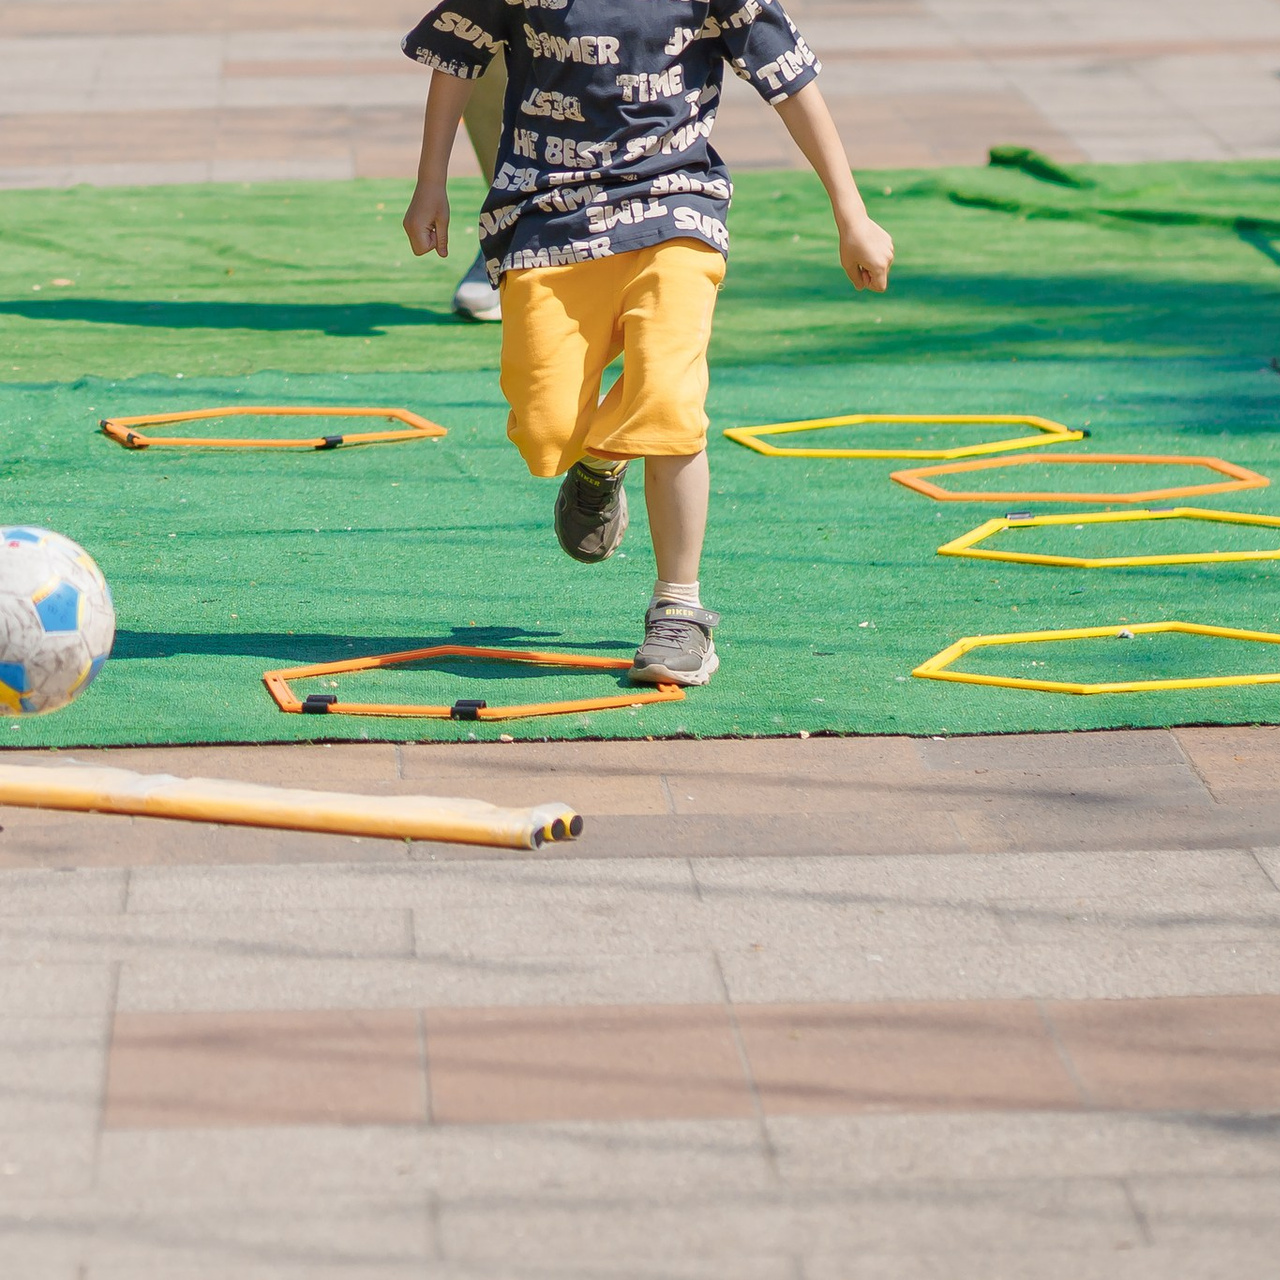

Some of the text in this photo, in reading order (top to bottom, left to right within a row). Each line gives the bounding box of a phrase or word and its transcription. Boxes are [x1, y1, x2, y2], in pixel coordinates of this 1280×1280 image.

[545, 136, 618, 169] BEST
[500, 236, 615, 270] UMMER
[665, 608, 694, 617] BIKER
